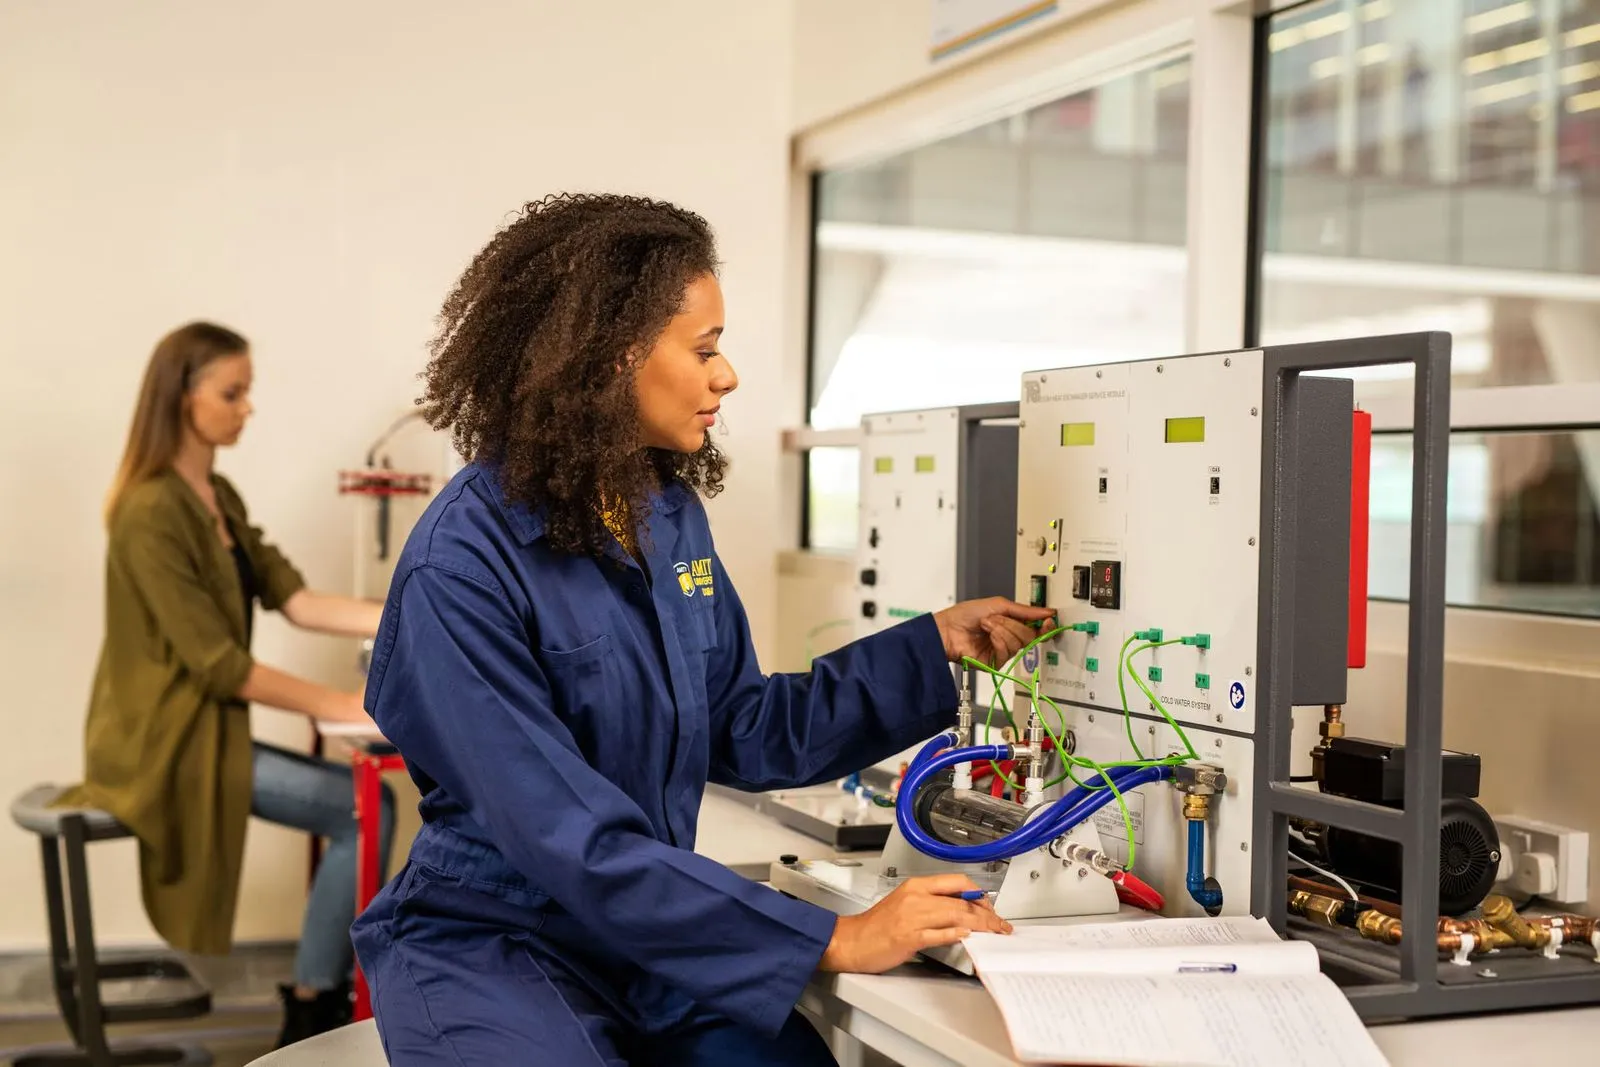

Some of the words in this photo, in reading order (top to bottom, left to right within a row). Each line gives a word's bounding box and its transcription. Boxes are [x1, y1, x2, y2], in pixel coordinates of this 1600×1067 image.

[1160, 695, 1174, 705] COLD
[1174, 698, 1190, 707] WATER
[1191, 700, 1211, 711] SYSTEM
